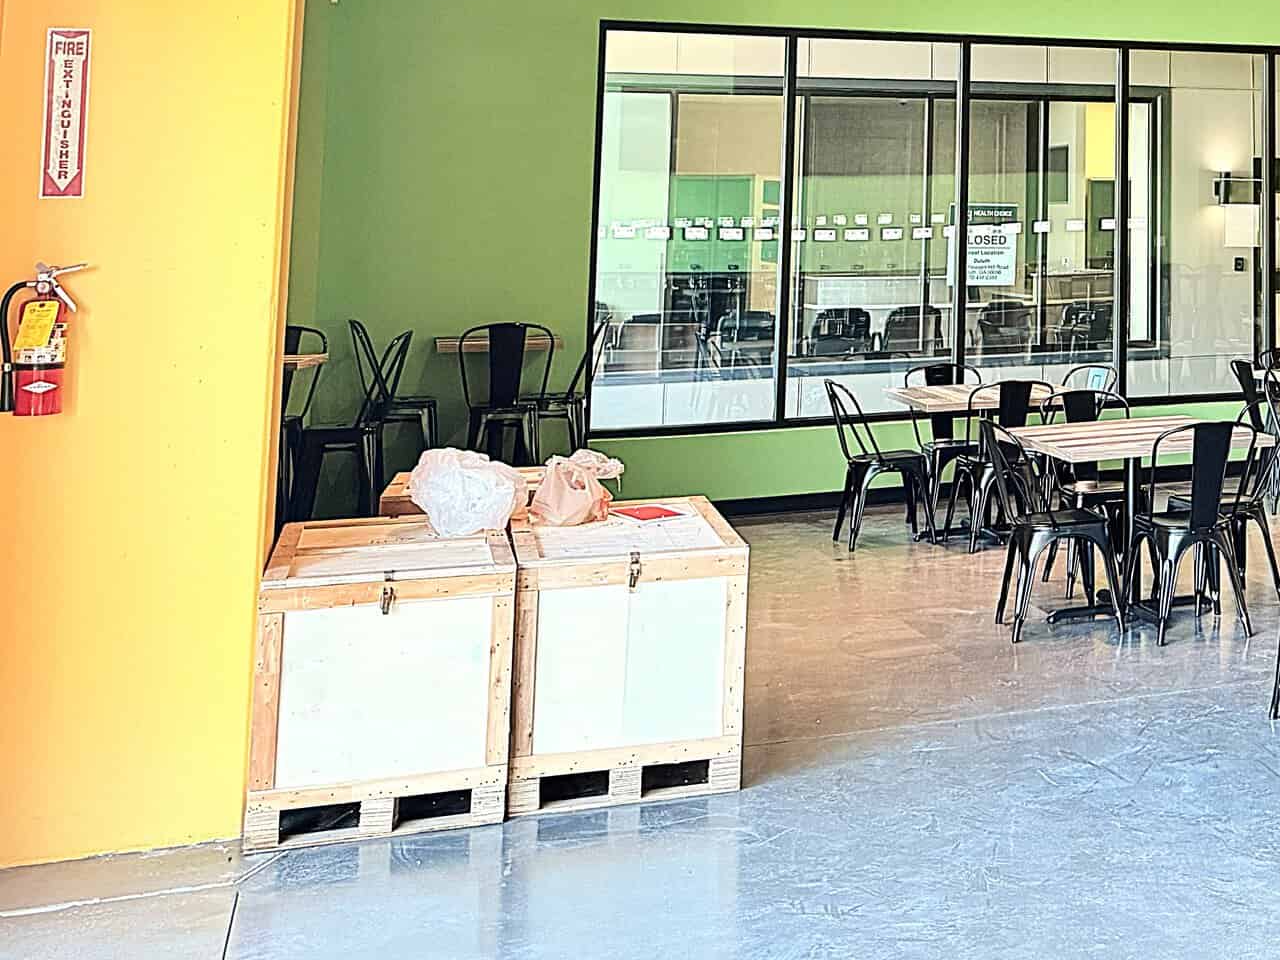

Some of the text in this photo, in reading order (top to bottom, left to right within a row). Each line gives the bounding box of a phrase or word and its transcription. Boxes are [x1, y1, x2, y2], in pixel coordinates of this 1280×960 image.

[55, 41, 84, 56] FIRE
[58, 59, 74, 180] EXTINGUISHER
[968, 235, 1007, 245] LOSED
